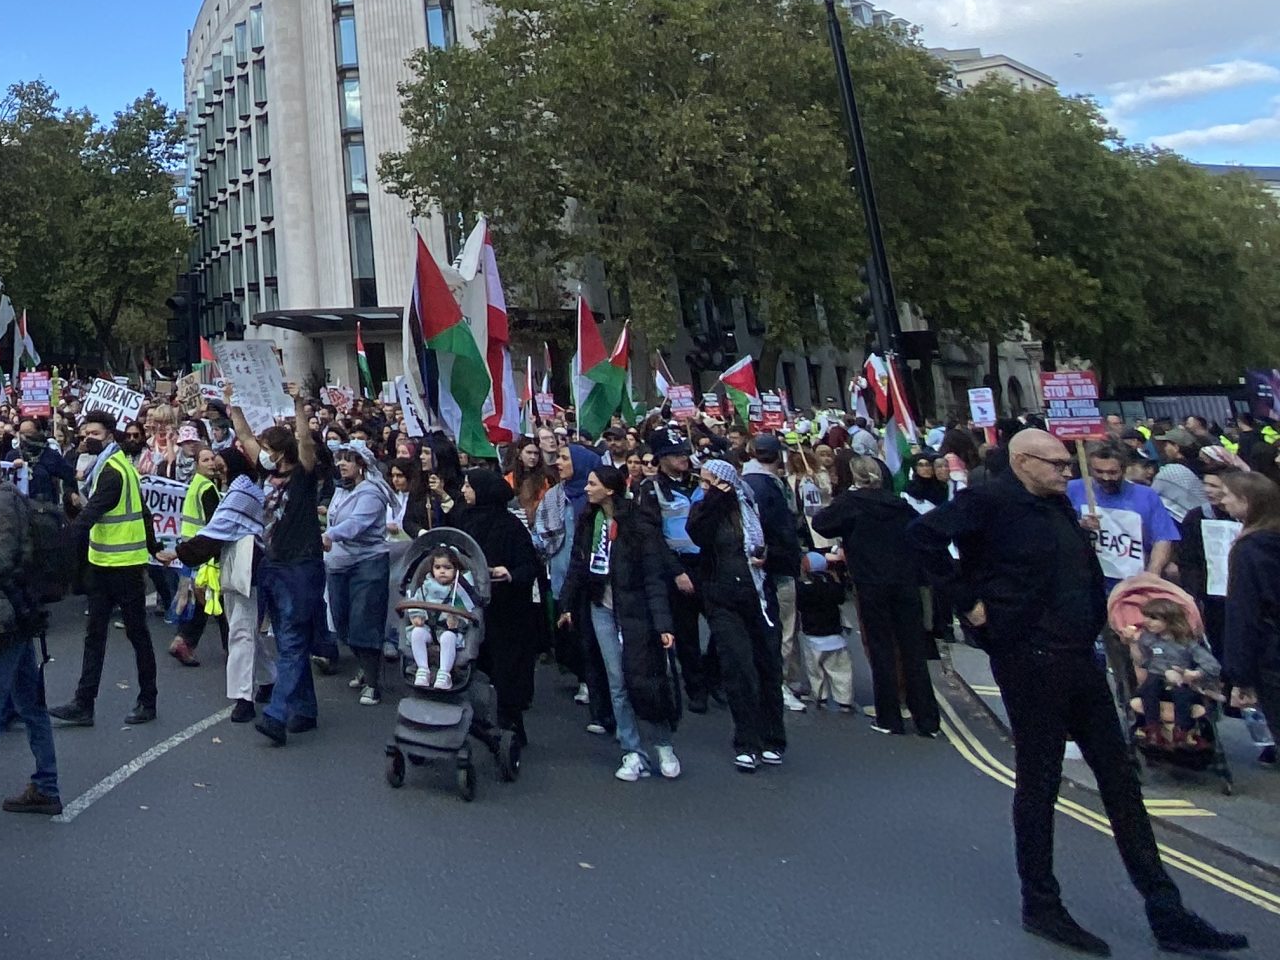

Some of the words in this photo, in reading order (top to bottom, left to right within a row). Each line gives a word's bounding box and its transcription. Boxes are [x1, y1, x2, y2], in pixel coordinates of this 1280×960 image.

[90, 380, 143, 410] STUDENTS
[1043, 385, 1070, 397] STOP
[1071, 385, 1097, 397] WAR
